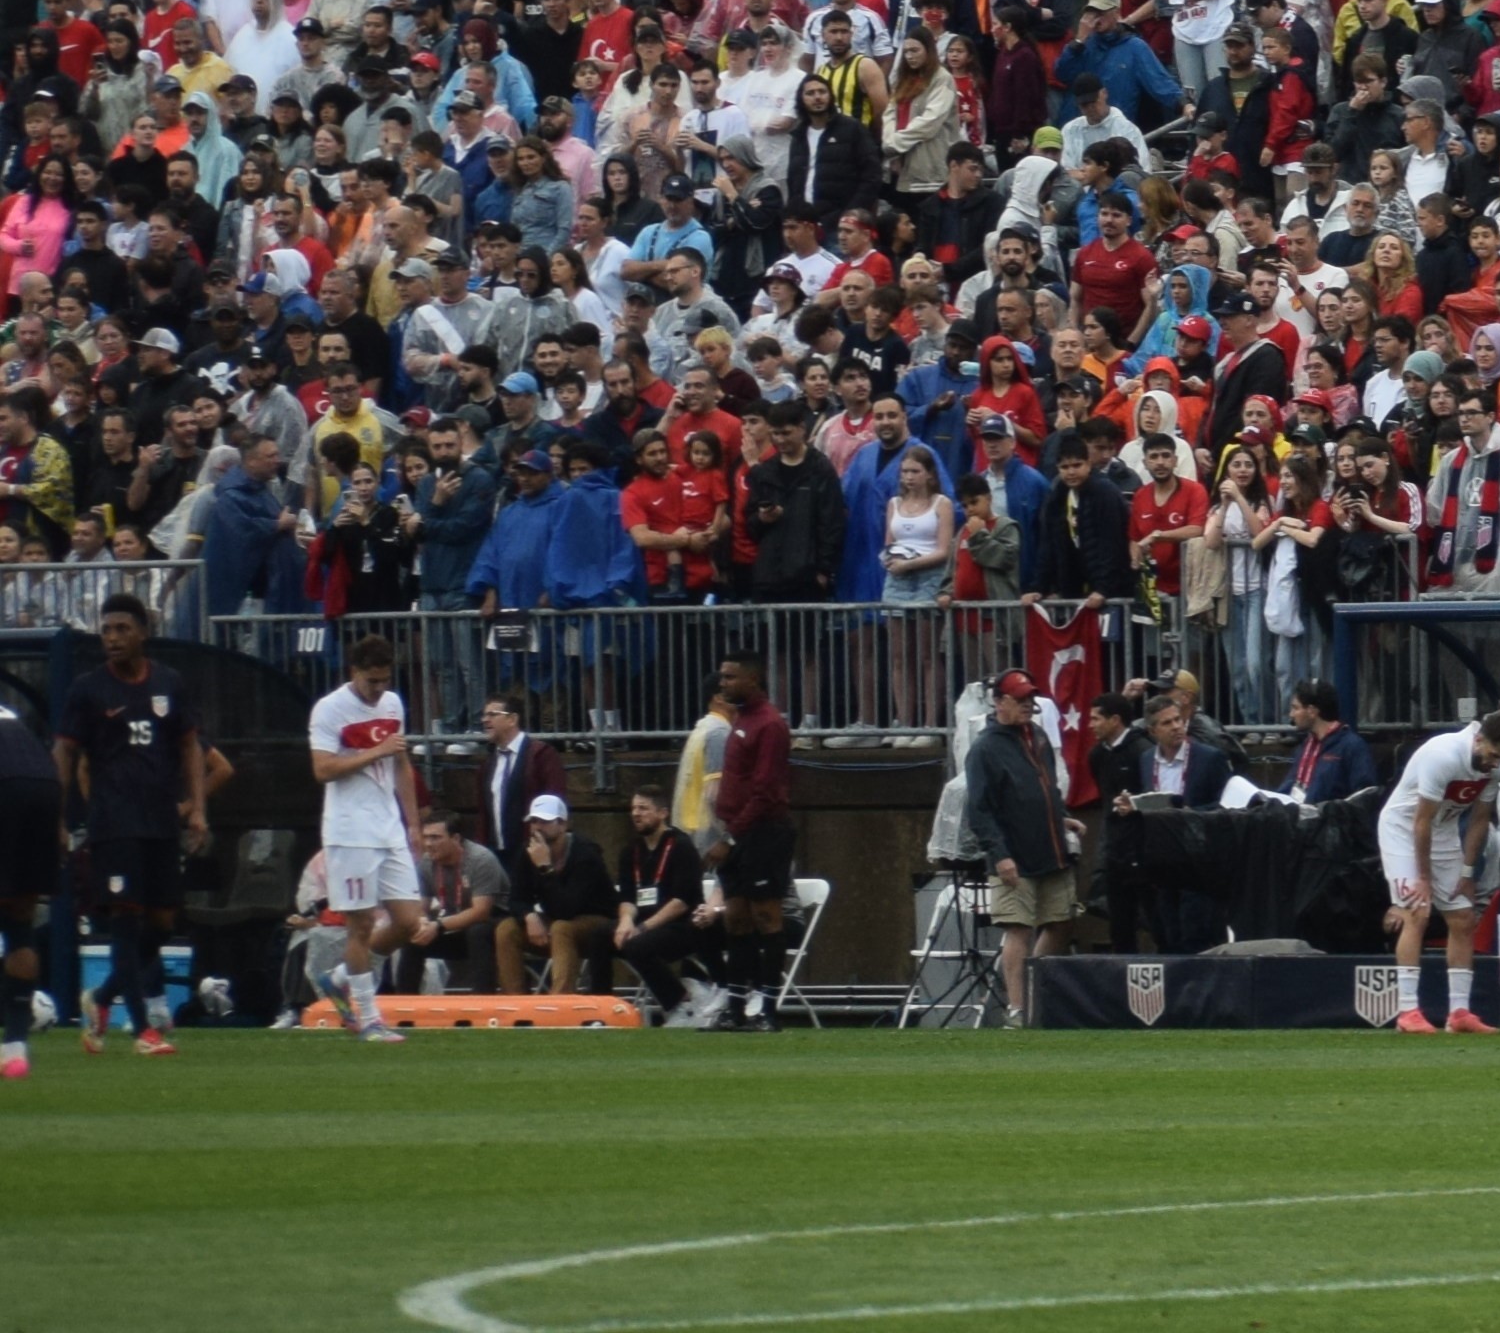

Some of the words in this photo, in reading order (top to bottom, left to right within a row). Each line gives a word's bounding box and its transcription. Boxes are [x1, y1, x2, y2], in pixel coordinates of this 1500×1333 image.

[297, 628, 325, 652] 101
[346, 878, 365, 900] 11
[1129, 965, 1164, 985] USA
[1357, 967, 1397, 986] USA
